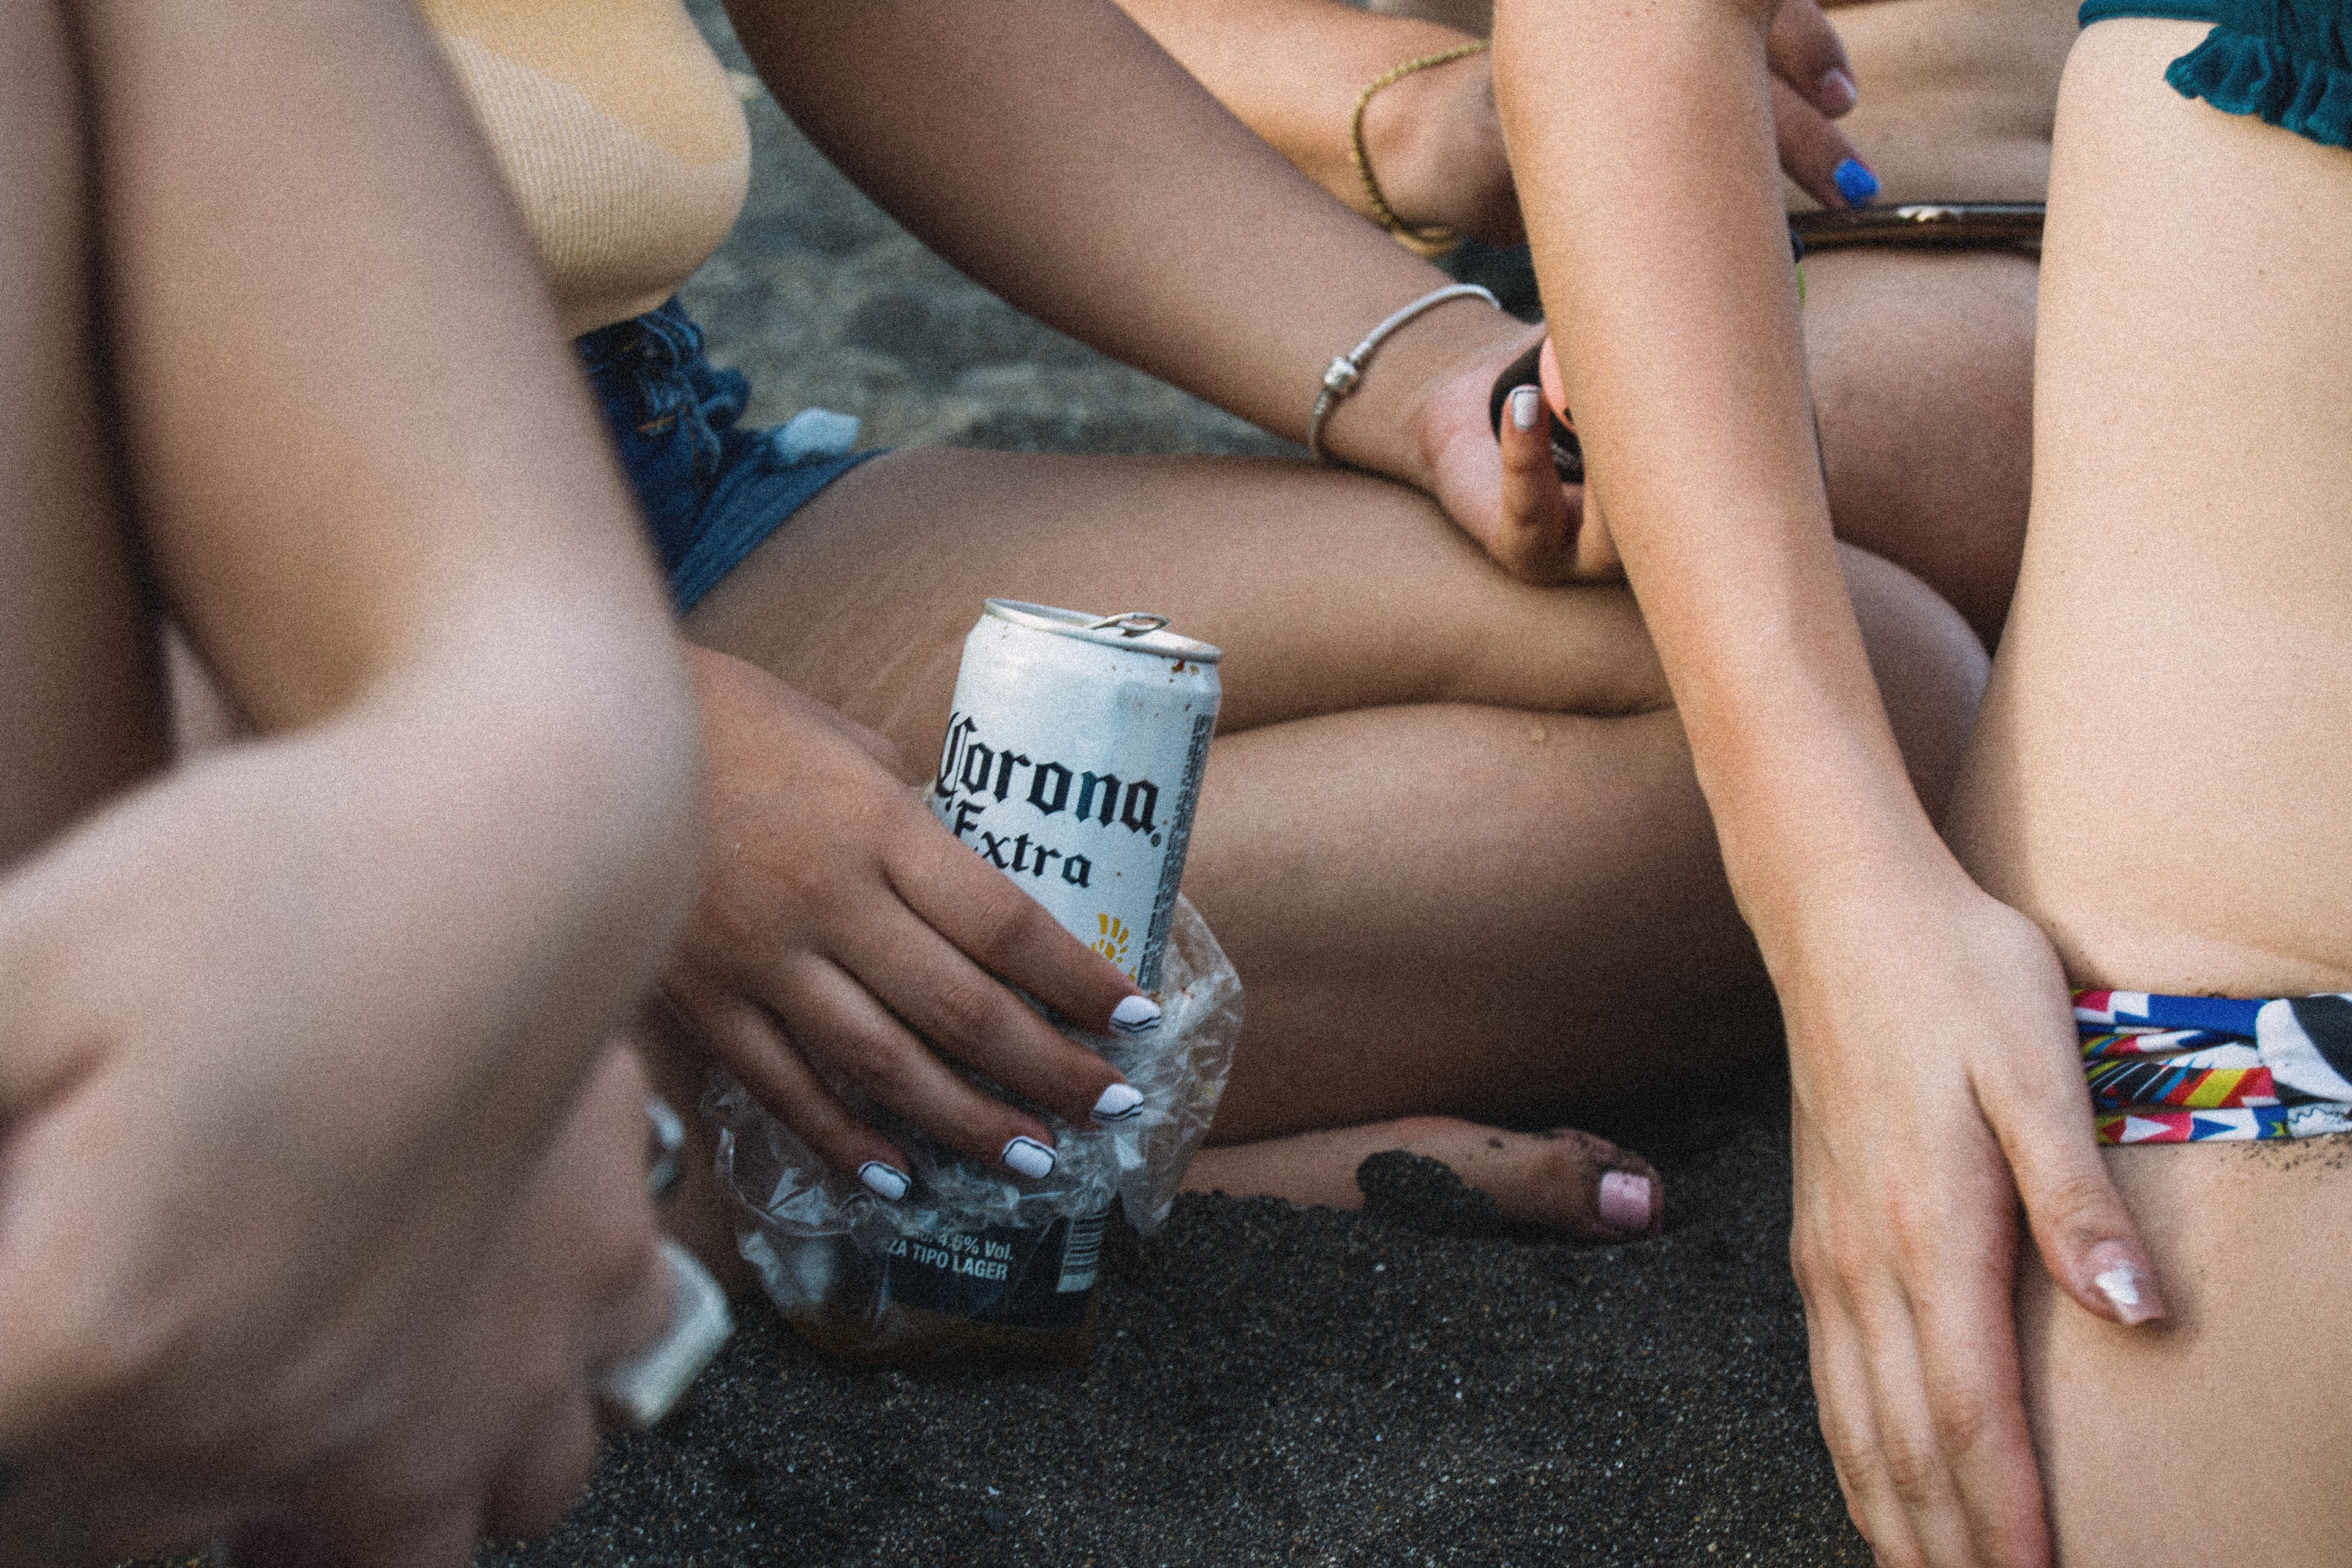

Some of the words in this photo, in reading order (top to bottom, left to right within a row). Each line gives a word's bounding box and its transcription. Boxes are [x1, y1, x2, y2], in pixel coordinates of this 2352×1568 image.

[935, 712, 1159, 835] Corona
[954, 799, 1091, 888] Extra
[913, 1243, 949, 1268] TIPO
[952, 1254, 1008, 1281] LAGER
[984, 1240, 1013, 1261] Vol.
